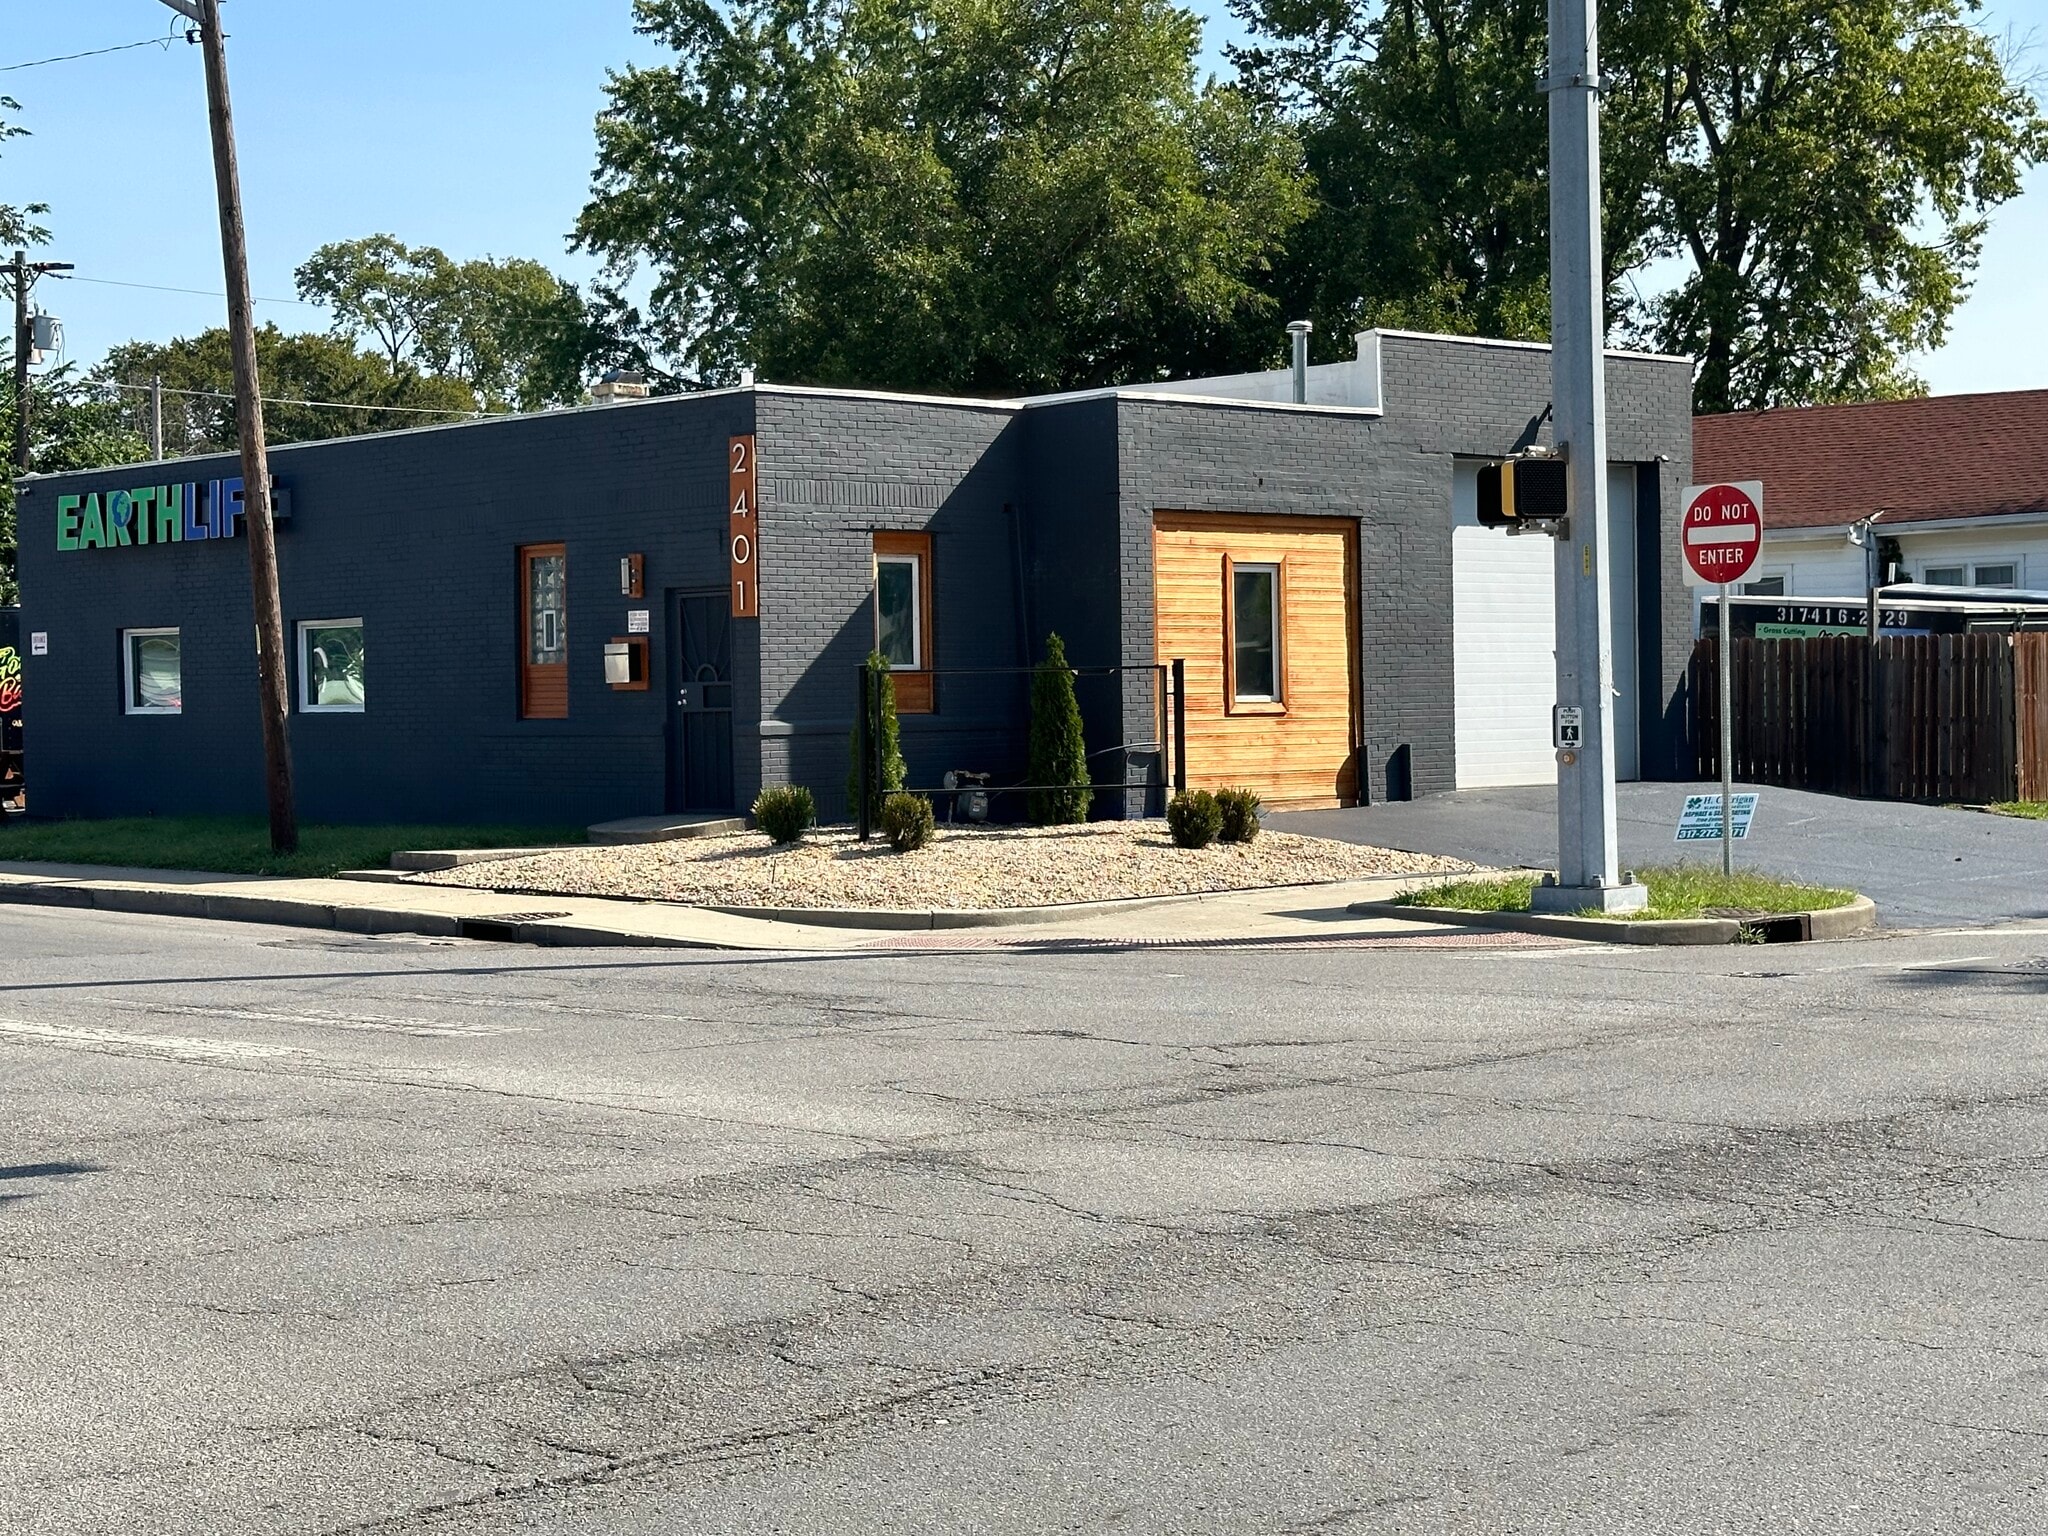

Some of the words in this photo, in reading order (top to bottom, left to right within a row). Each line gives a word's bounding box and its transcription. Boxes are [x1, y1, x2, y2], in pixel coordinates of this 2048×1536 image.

[57, 475, 271, 551] EARTHLIF
[732, 443, 750, 611] 2401
[1694, 506, 1712, 522] DO
[1721, 503, 1749, 520] NOT
[1699, 548, 1744, 565] ENTER
